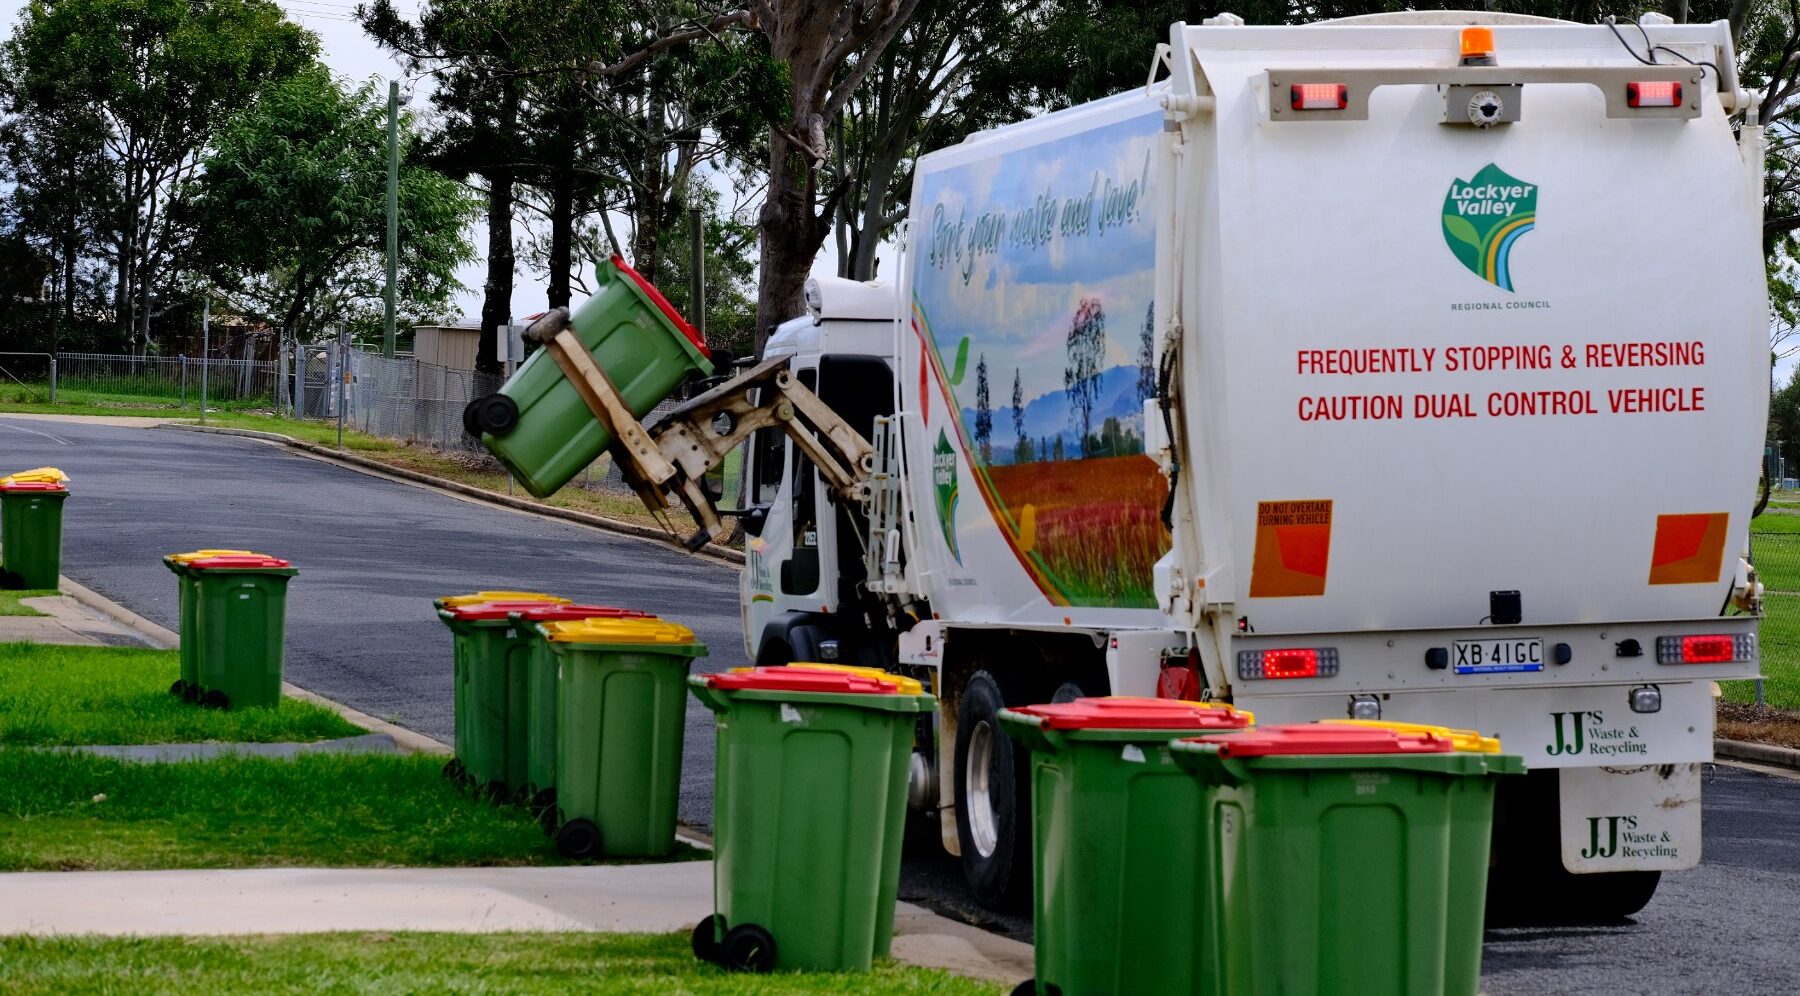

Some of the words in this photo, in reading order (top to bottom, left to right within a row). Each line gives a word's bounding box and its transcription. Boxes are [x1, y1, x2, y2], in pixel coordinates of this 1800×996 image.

[1451, 183, 1534, 201] Lockyer
[1456, 199, 1517, 217] Valley
[929, 202, 967, 268] Sort
[962, 209, 1006, 286] your
[1008, 184, 1058, 251] waste
[1060, 169, 1099, 237] and
[1098, 147, 1151, 237] save!
[1451, 302, 1503, 311] REGIONAL
[1505, 300, 1551, 310] COUNCIL
[1298, 347, 1436, 375] FREQUENTLY
[1445, 345, 1552, 372] STOPPING
[1560, 344, 1577, 369] &
[1585, 341, 1705, 368] REVERSING
[1297, 395, 1403, 421] CAUTION
[1413, 393, 1477, 418] DUAL
[1487, 390, 1598, 417] CONTROL
[1607, 387, 1706, 413] VEHICLE
[1259, 503, 1270, 515] DO
[1272, 502, 1289, 514] NOT
[1290, 501, 1330, 514] OVERTAKE
[1258, 514, 1294, 526] TURNING
[1295, 512, 1329, 525] VEHICLE
[1546, 710, 1604, 756] JJ'S
[1588, 727, 1625, 740] Waste
[1628, 726, 1640, 738] &
[1589, 741, 1648, 756] Recycling
[1581, 815, 1638, 859] JJ'S
[1622, 832, 1657, 844] Waste
[1659, 831, 1671, 842] &
[1622, 845, 1678, 859] Recycling
